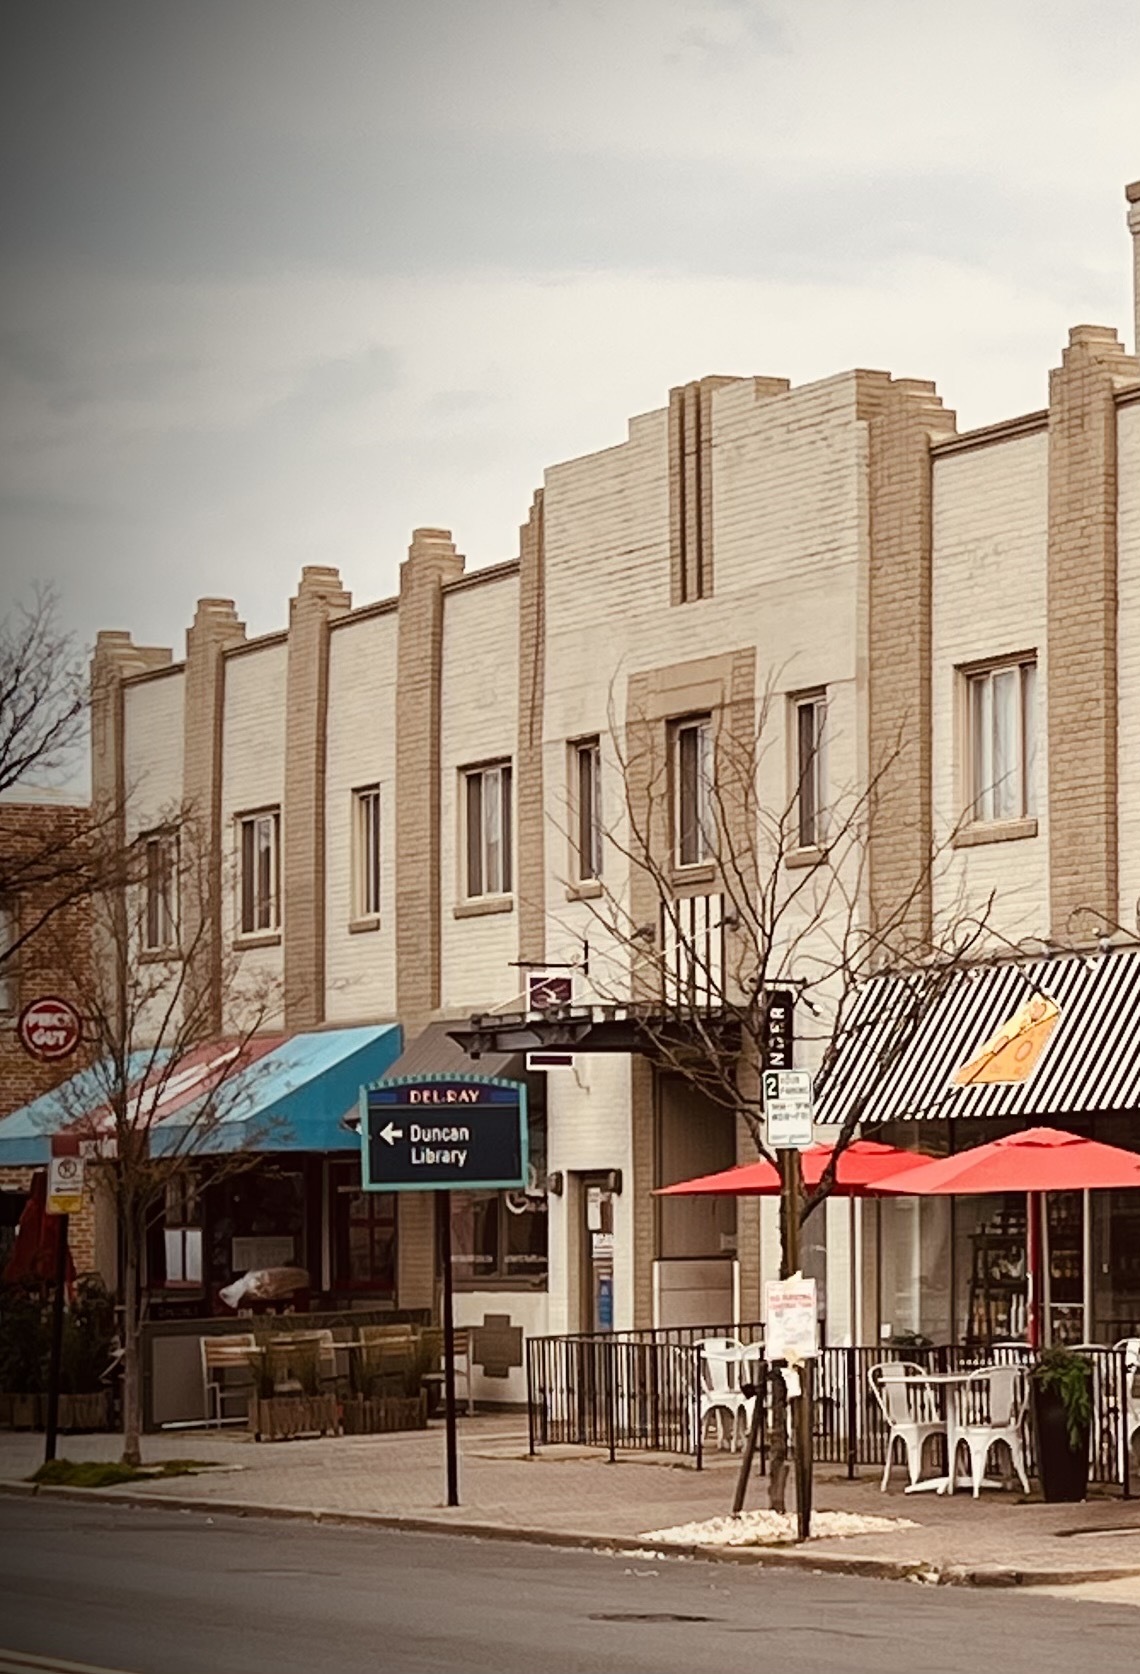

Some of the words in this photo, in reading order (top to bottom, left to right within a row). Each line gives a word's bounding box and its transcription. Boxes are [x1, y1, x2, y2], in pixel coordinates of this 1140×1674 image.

[409, 1089, 444, 1104] DEL
[446, 1089, 480, 1103] RAY
[766, 1078, 778, 1097] 2
[410, 1124, 470, 1143] Duncan
[411, 1147, 468, 1168] Library
